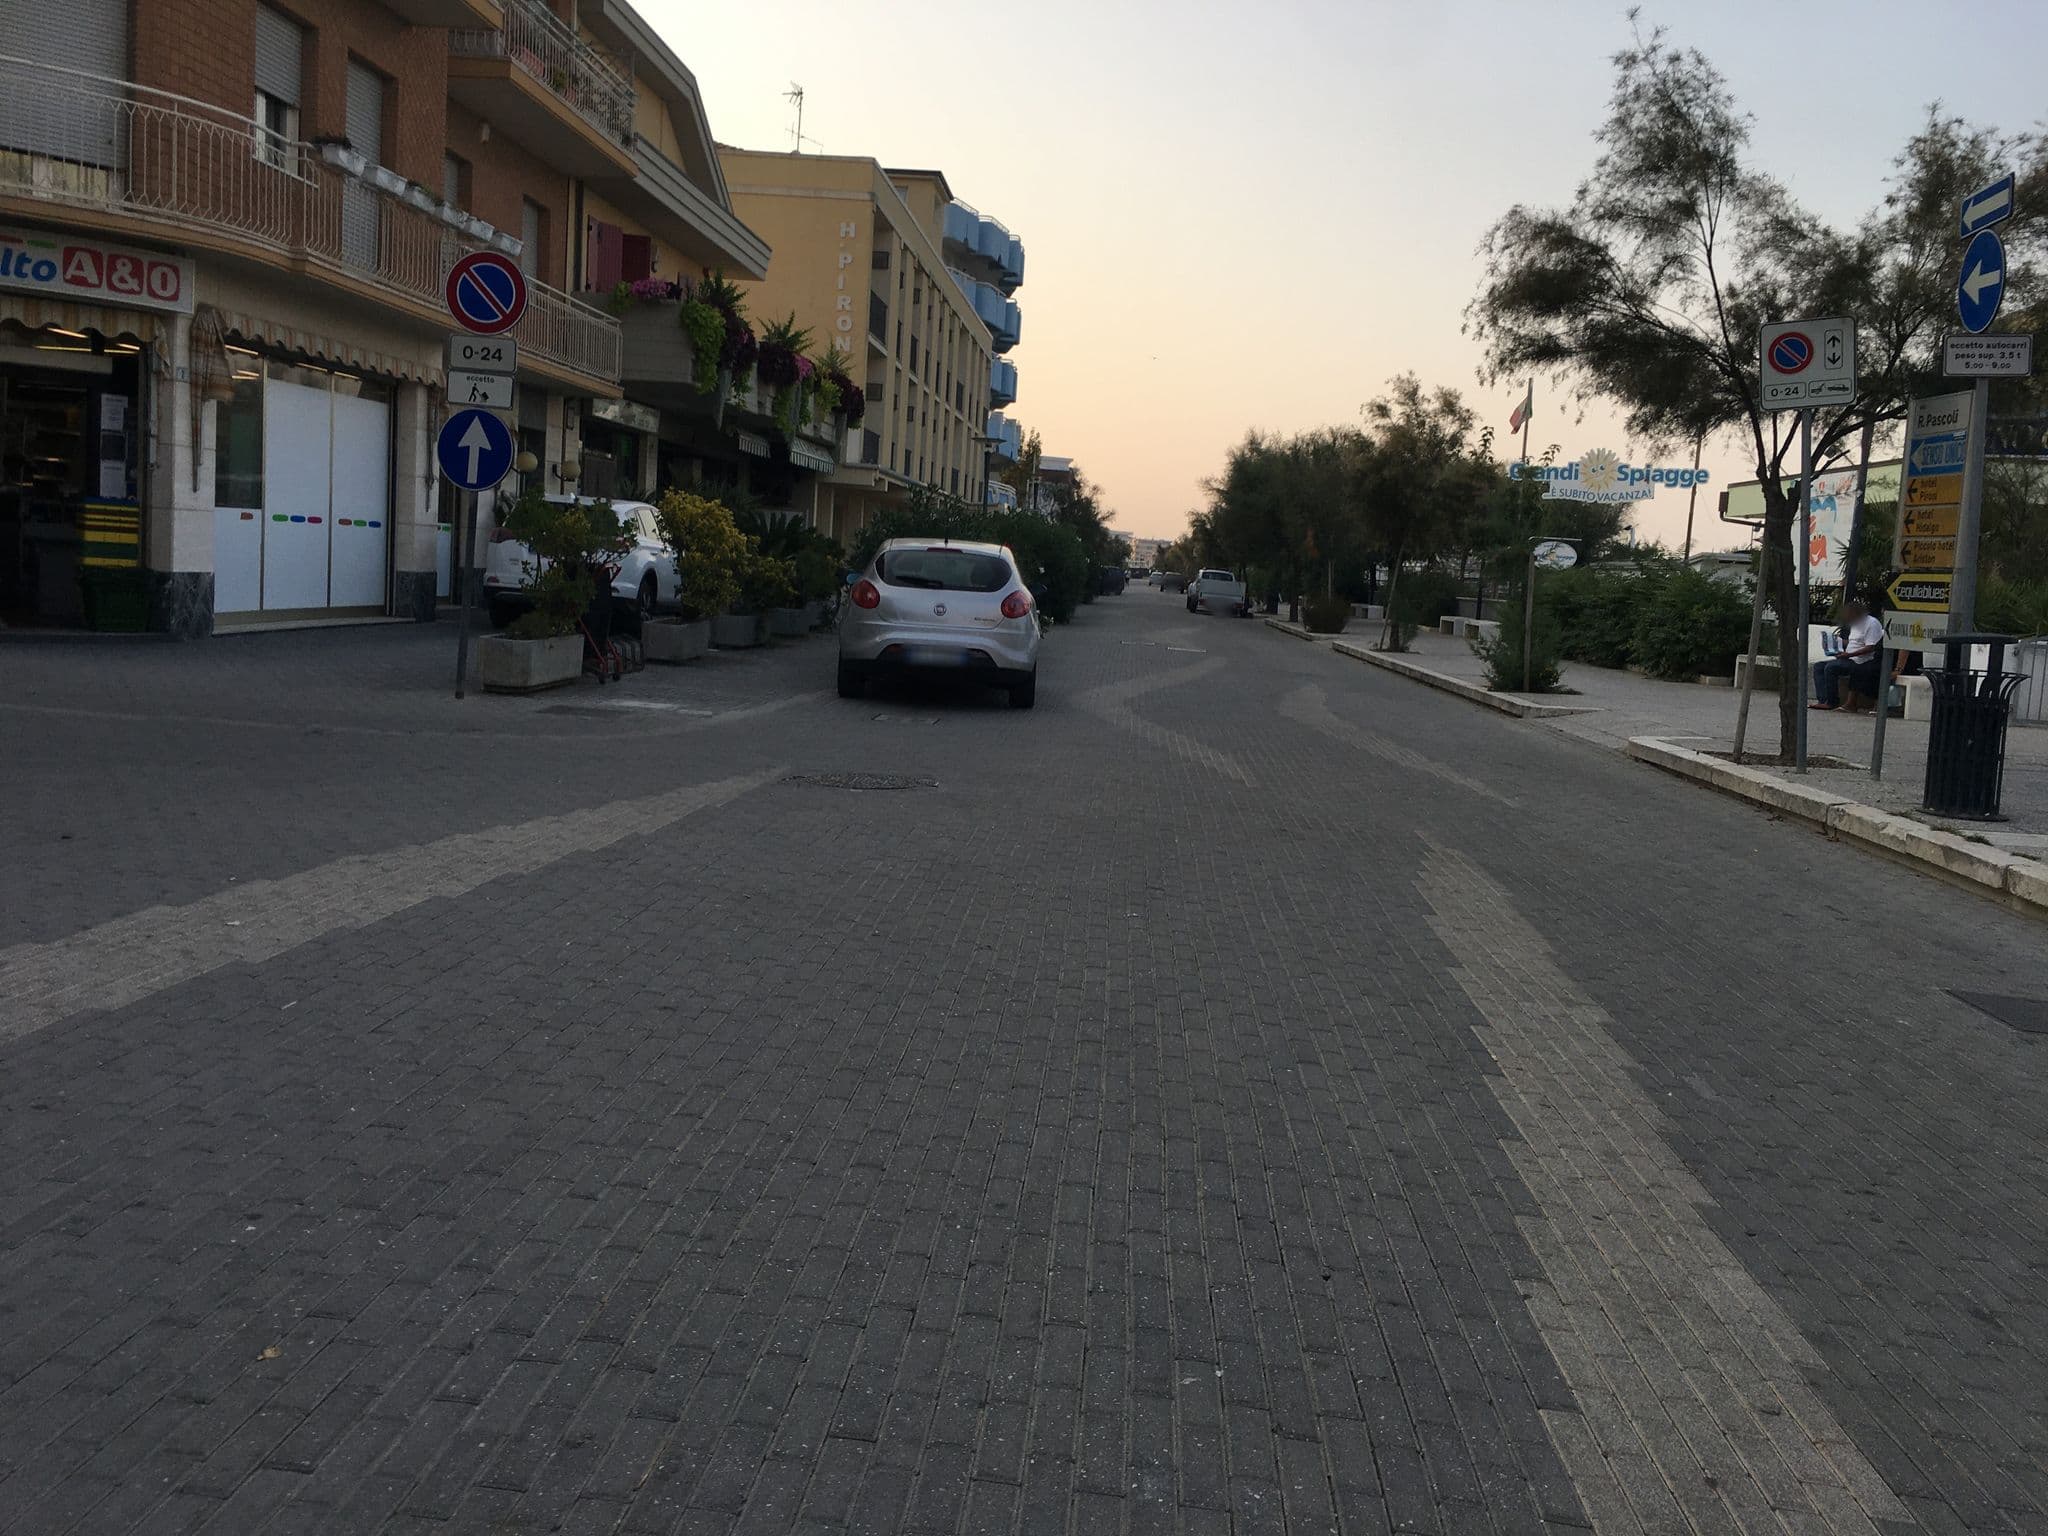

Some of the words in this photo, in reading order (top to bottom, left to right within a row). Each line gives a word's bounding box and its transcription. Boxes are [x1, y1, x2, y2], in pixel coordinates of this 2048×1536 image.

[64, 249, 179, 299] A&O
[1986, 341, 2027, 349] autocarri
[462, 345, 503, 362] 0-24
[1771, 386, 1799, 397] 0-24
[1616, 463, 1710, 487] Spiagge
[1559, 488, 1596, 502] SUBITO
[1597, 489, 1653, 502] VACANZA!
